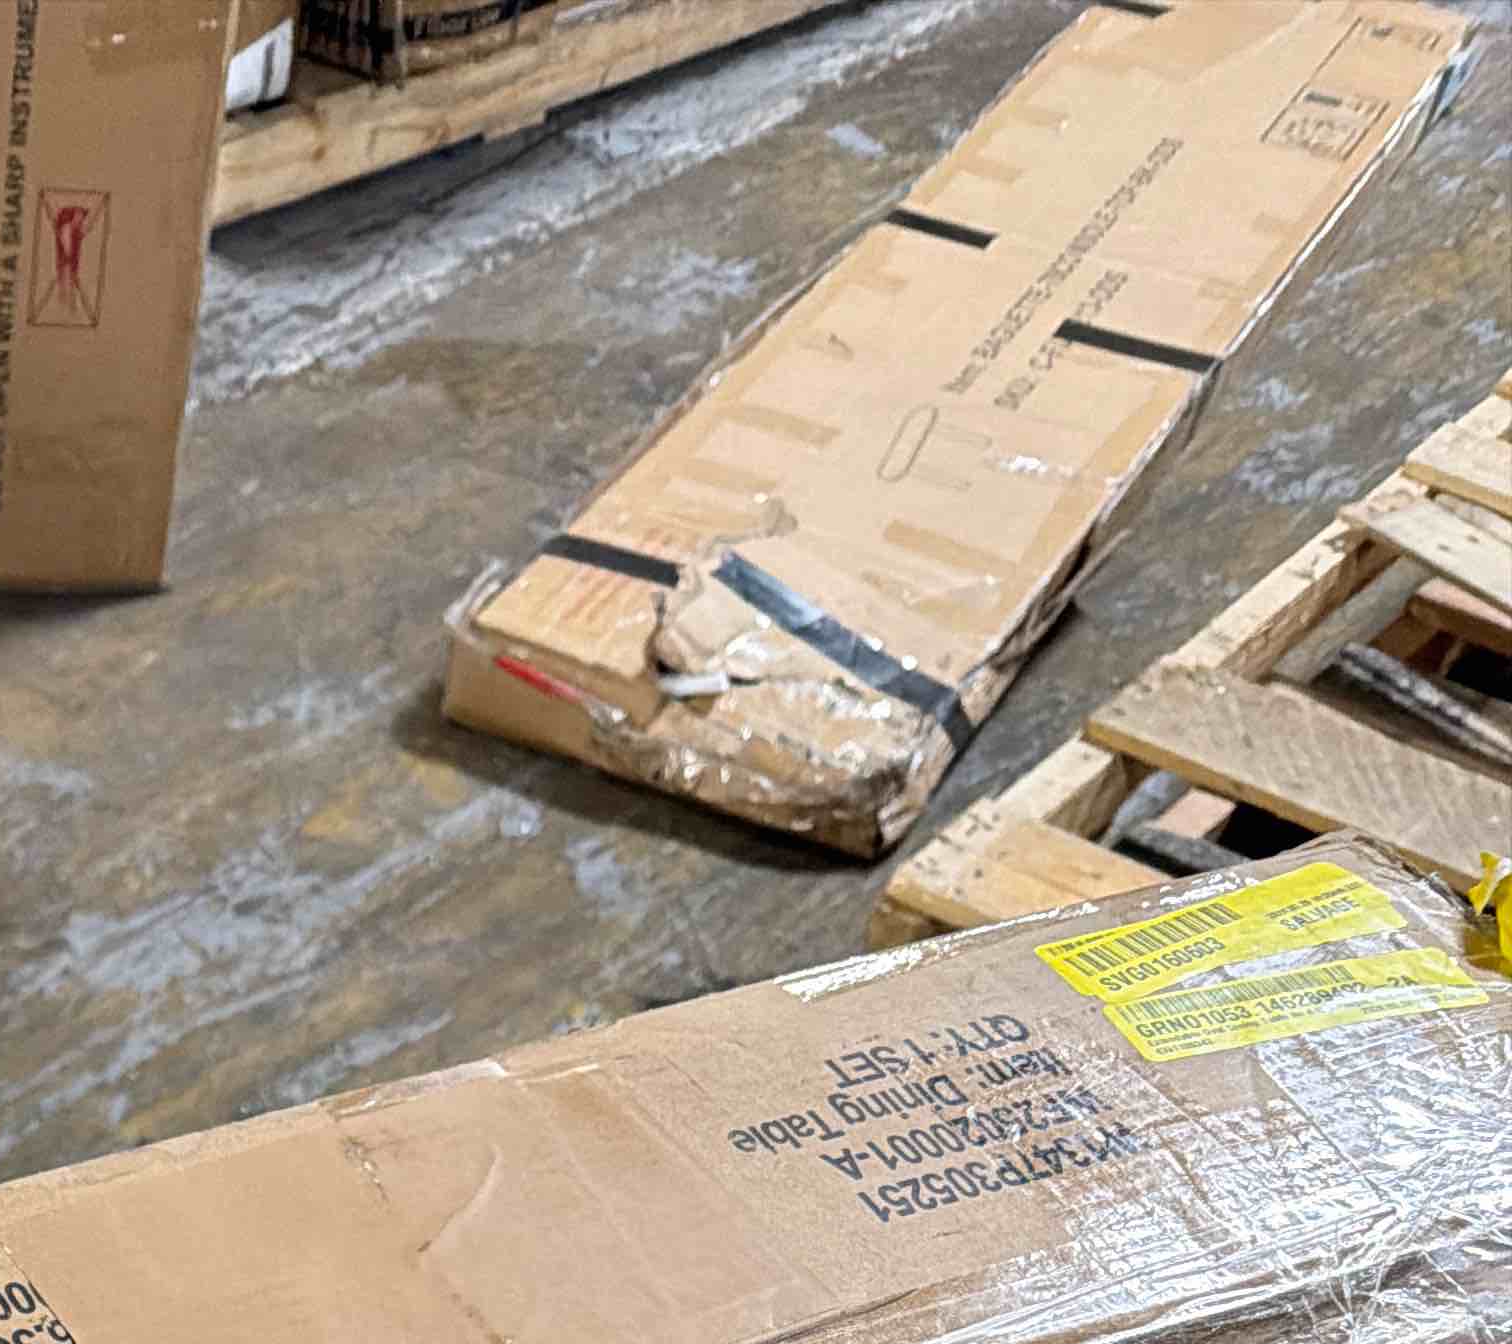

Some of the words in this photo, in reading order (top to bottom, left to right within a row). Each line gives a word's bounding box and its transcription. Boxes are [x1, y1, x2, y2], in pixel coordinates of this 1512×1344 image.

[0, 154, 25, 247] SHARP
[1279, 894, 1362, 933] SALVAGE
[823, 1045, 912, 1091] SET
[965, 1047, 1075, 1091] Item:
[827, 1073, 969, 1127] Dining
[727, 1112, 846, 1155] Table
